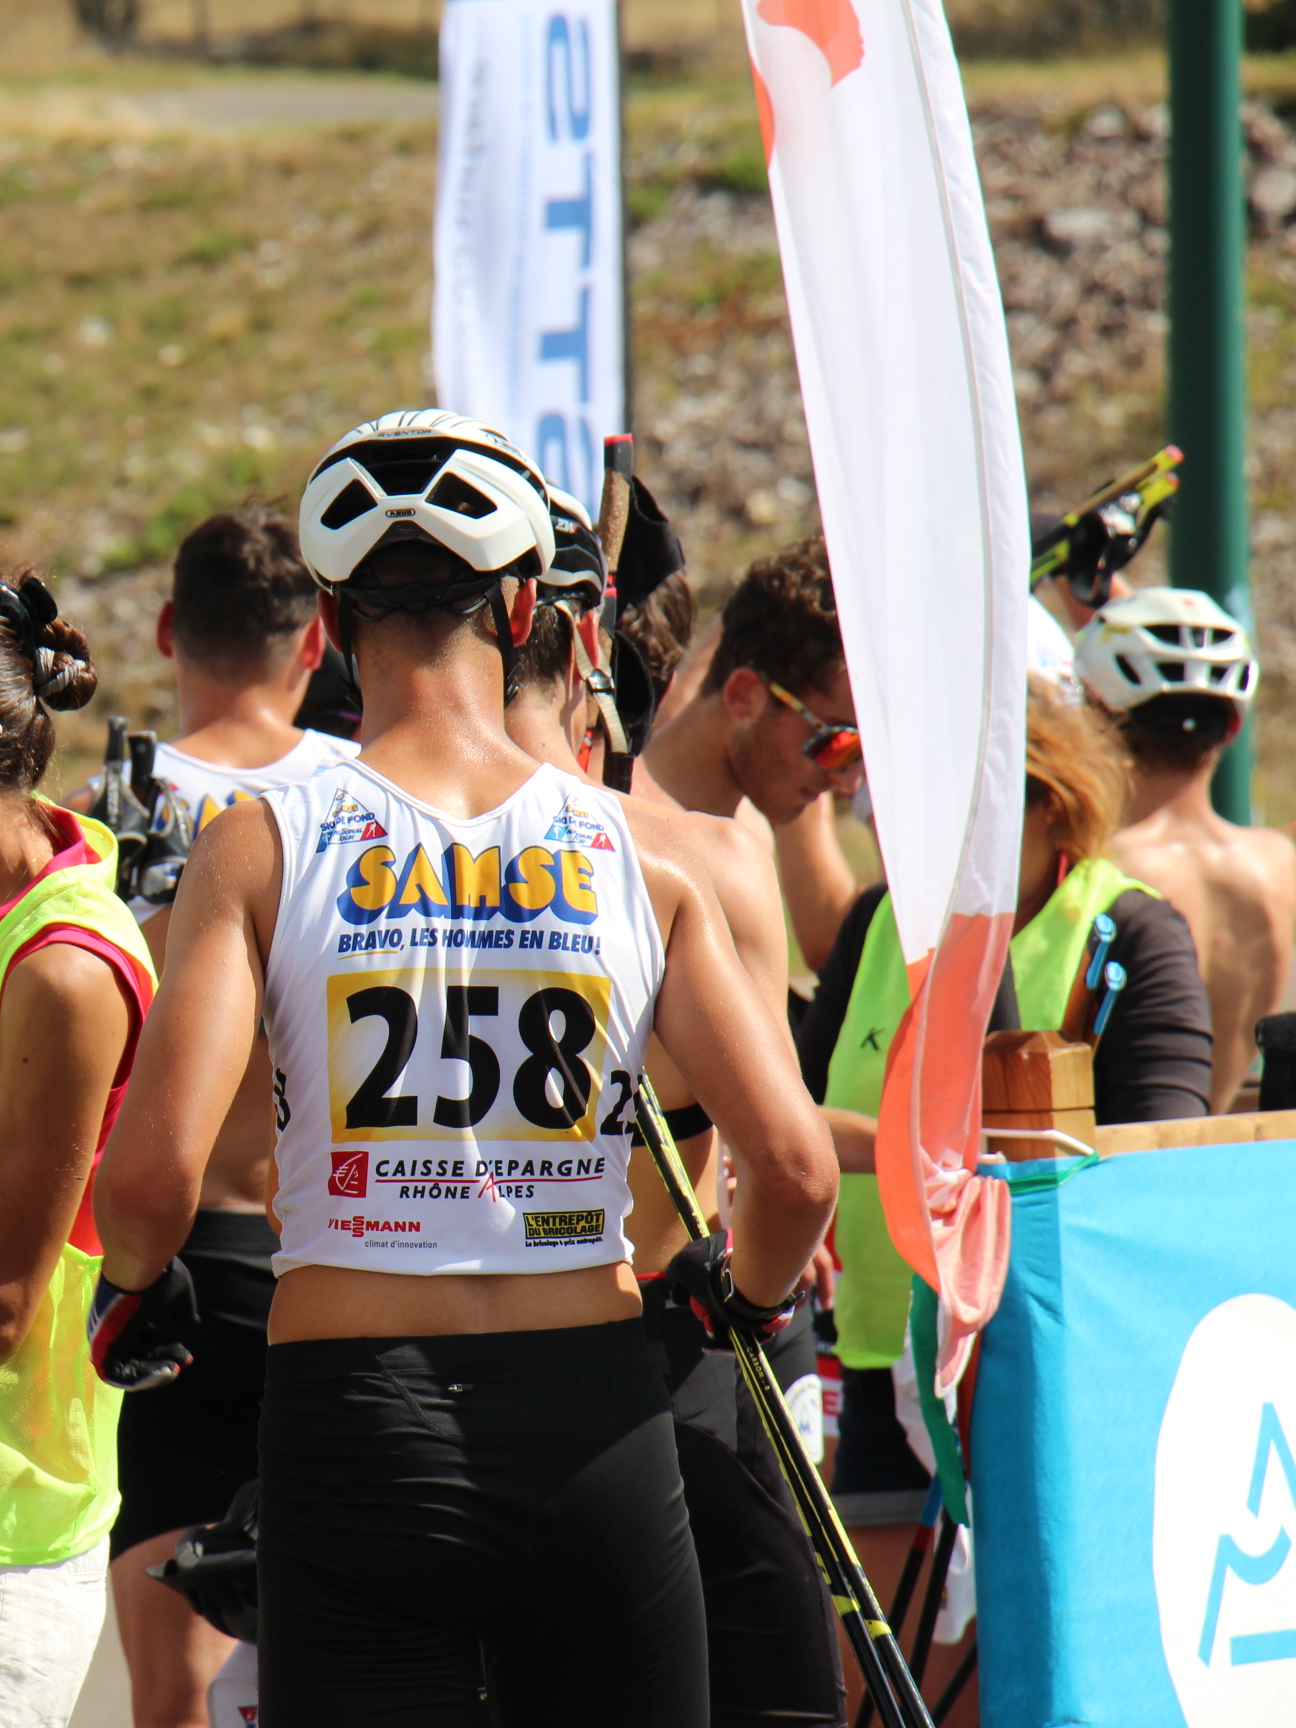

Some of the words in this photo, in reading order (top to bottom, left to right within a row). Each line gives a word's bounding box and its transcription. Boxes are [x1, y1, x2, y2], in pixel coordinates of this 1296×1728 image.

[347, 812, 375, 824] FOND
[337, 842, 598, 924] SAMSE
[337, 929, 405, 953] BRAVO,
[410, 927, 438, 948] LES
[441, 928, 514, 950] HOMMES
[518, 930, 543, 950] EN
[344, 984, 597, 1130] 258
[375, 1159, 464, 1178] CAISSE
[475, 1157, 606, 1177] D'EPARGNE
[399, 1181, 471, 1199] RHÔNE
[477, 1171, 536, 1203] ALPES
[328, 1215, 421, 1238] VIESSMANN
[525, 1212, 602, 1228] L'ENTREPÔT
[528, 1227, 542, 1237] DU
[543, 1224, 601, 1236] BRICOLAGE
[365, 1239, 387, 1249] climat
[390, 1239, 438, 1250] d'innovation
